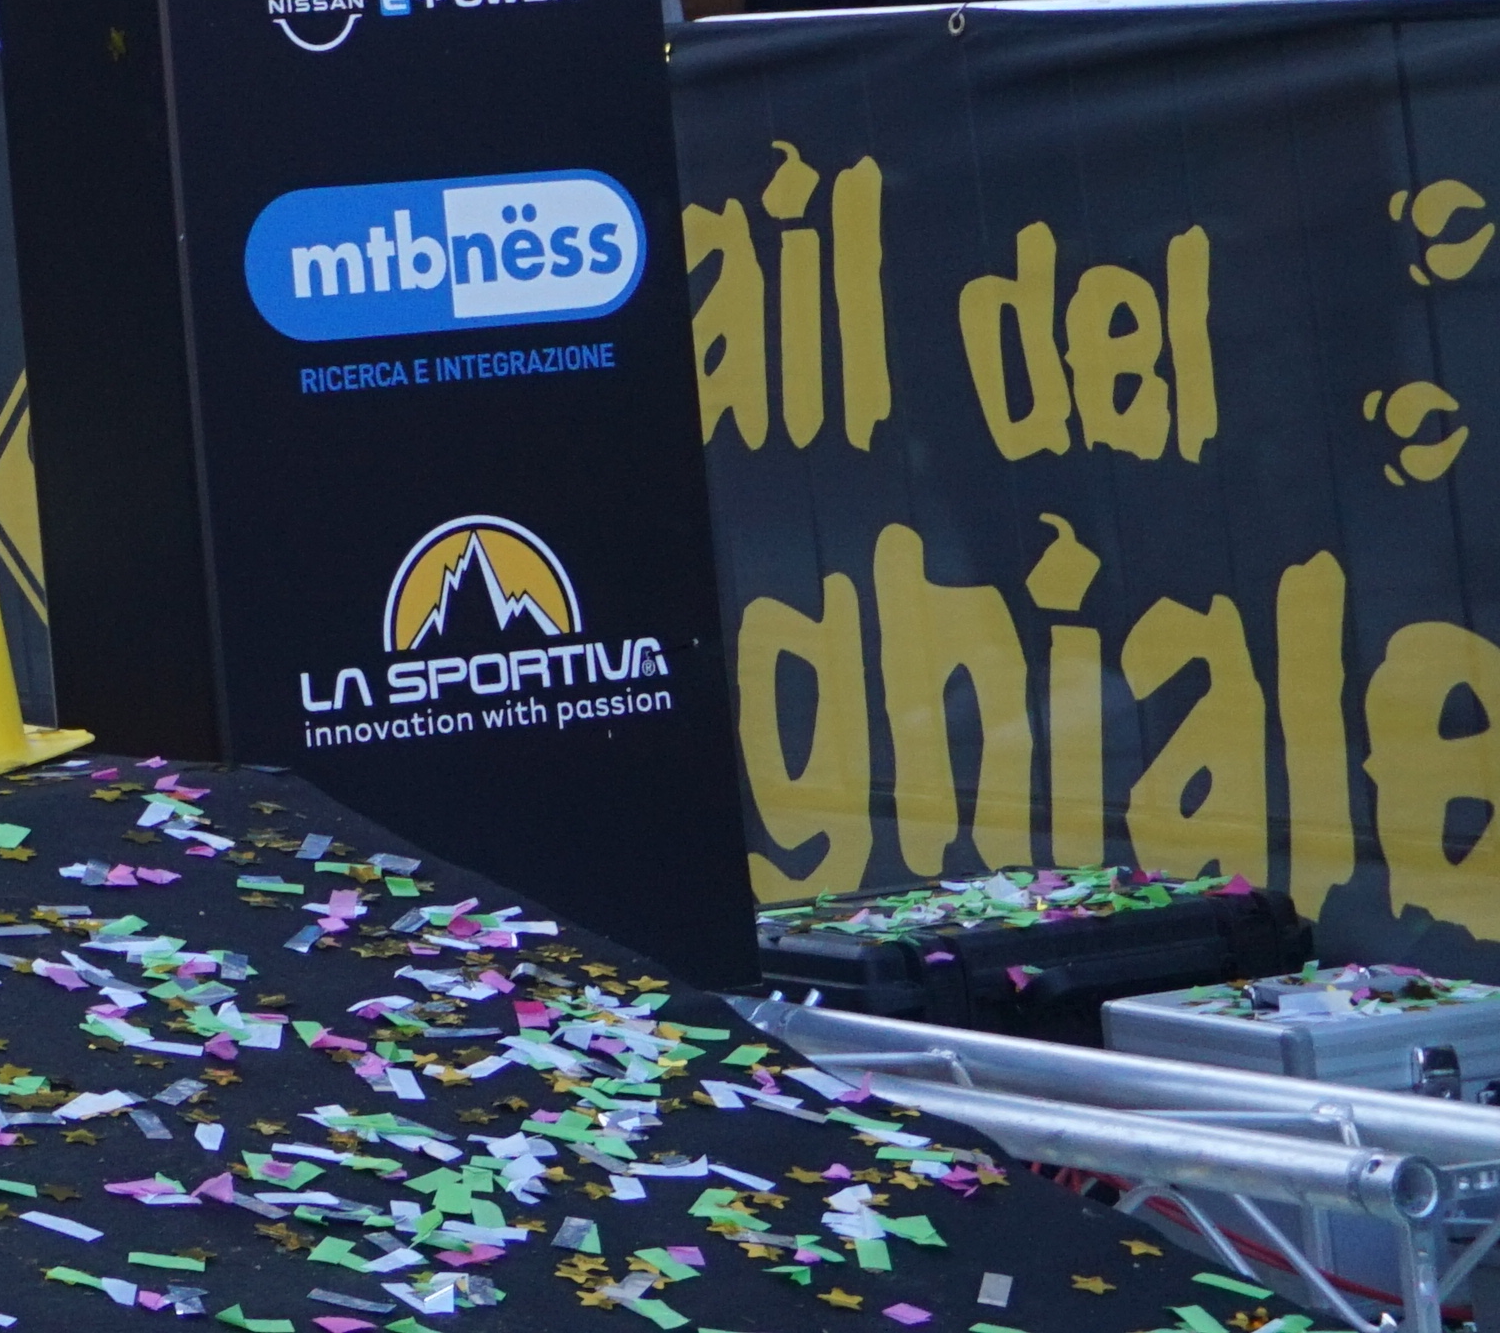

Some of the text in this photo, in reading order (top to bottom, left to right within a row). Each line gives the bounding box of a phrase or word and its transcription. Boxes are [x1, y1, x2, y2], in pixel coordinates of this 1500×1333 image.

[290, 206, 624, 298] mtbnëss
[682, 139, 1218, 463] ail del
[299, 341, 616, 395] RICERCA E INTEGRAZIONE
[300, 668, 373, 713] LA
[304, 686, 673, 748] innovation with passion
[738, 511, 1500, 943] ghiale
